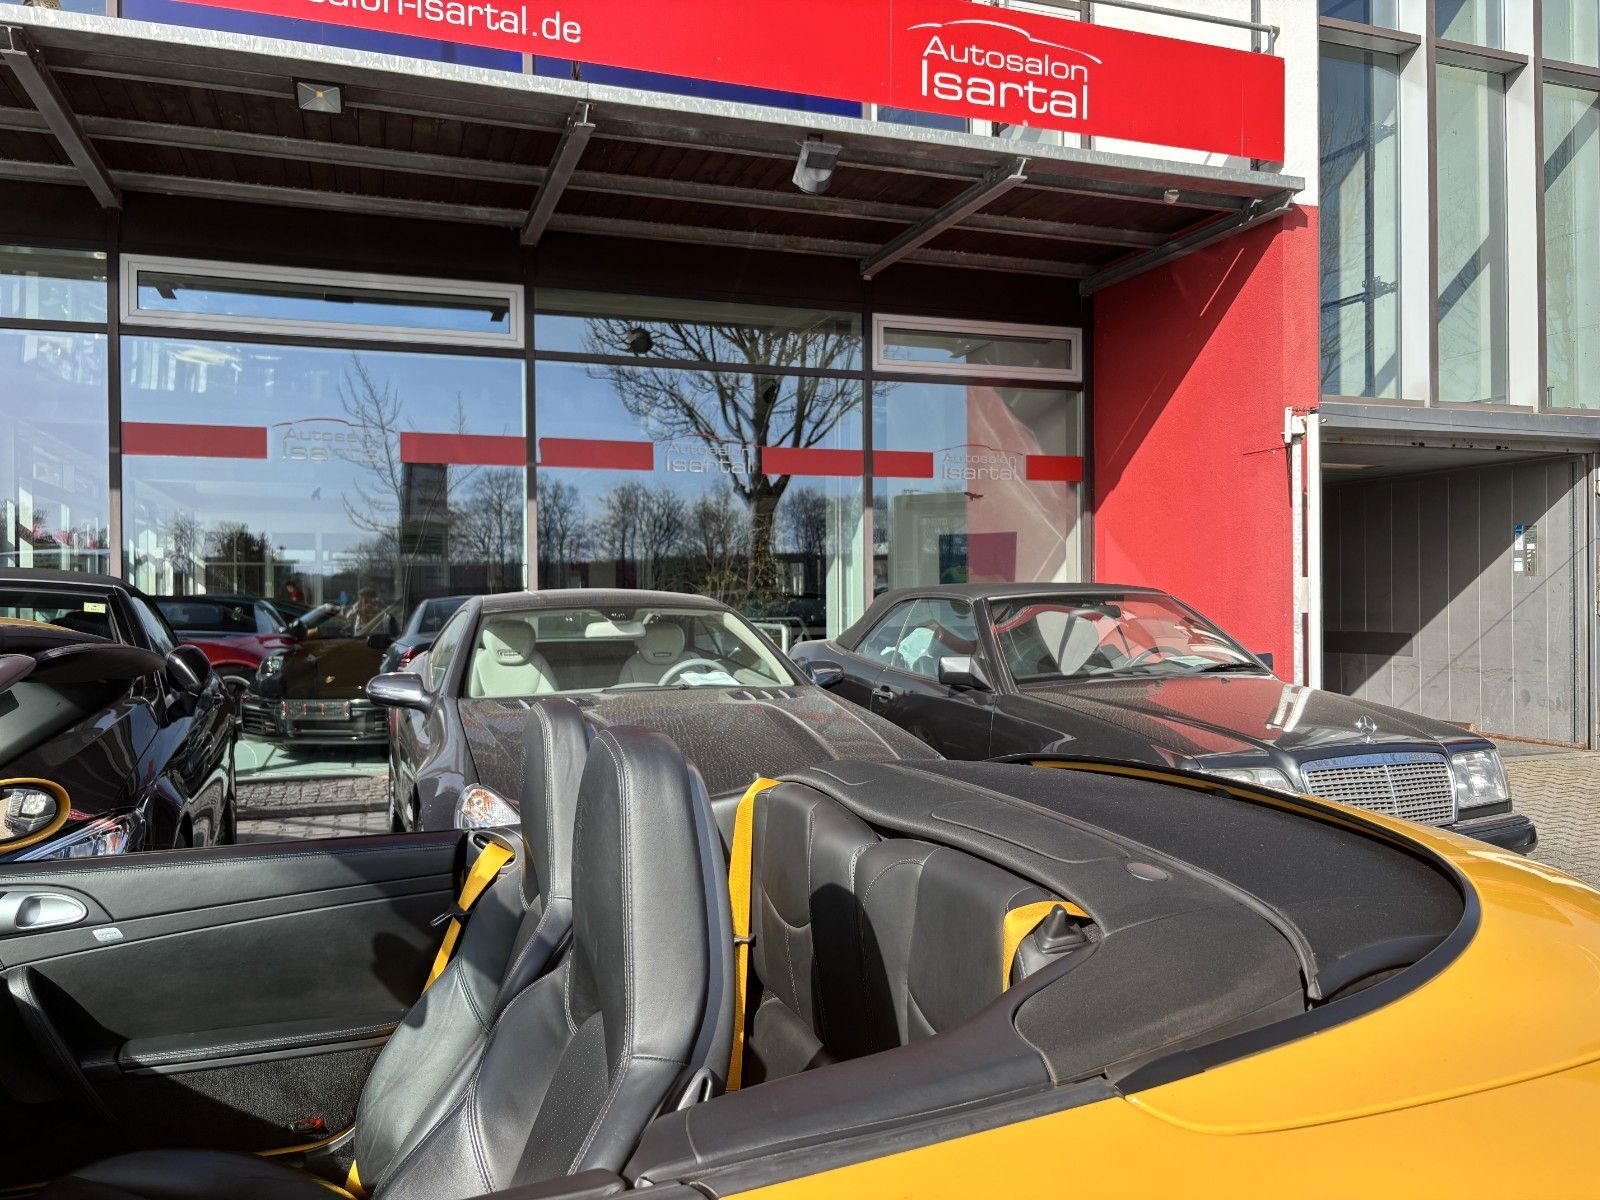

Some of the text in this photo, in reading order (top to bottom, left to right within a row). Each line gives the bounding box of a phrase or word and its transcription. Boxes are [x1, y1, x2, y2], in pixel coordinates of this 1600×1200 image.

[308, 0, 582, 43] on-Isartal.de
[922, 35, 1089, 83] Autosalon
[921, 59, 1089, 120] Isartal
[666, 454, 752, 474] Isartal
[942, 463, 1017, 481] Isartal
